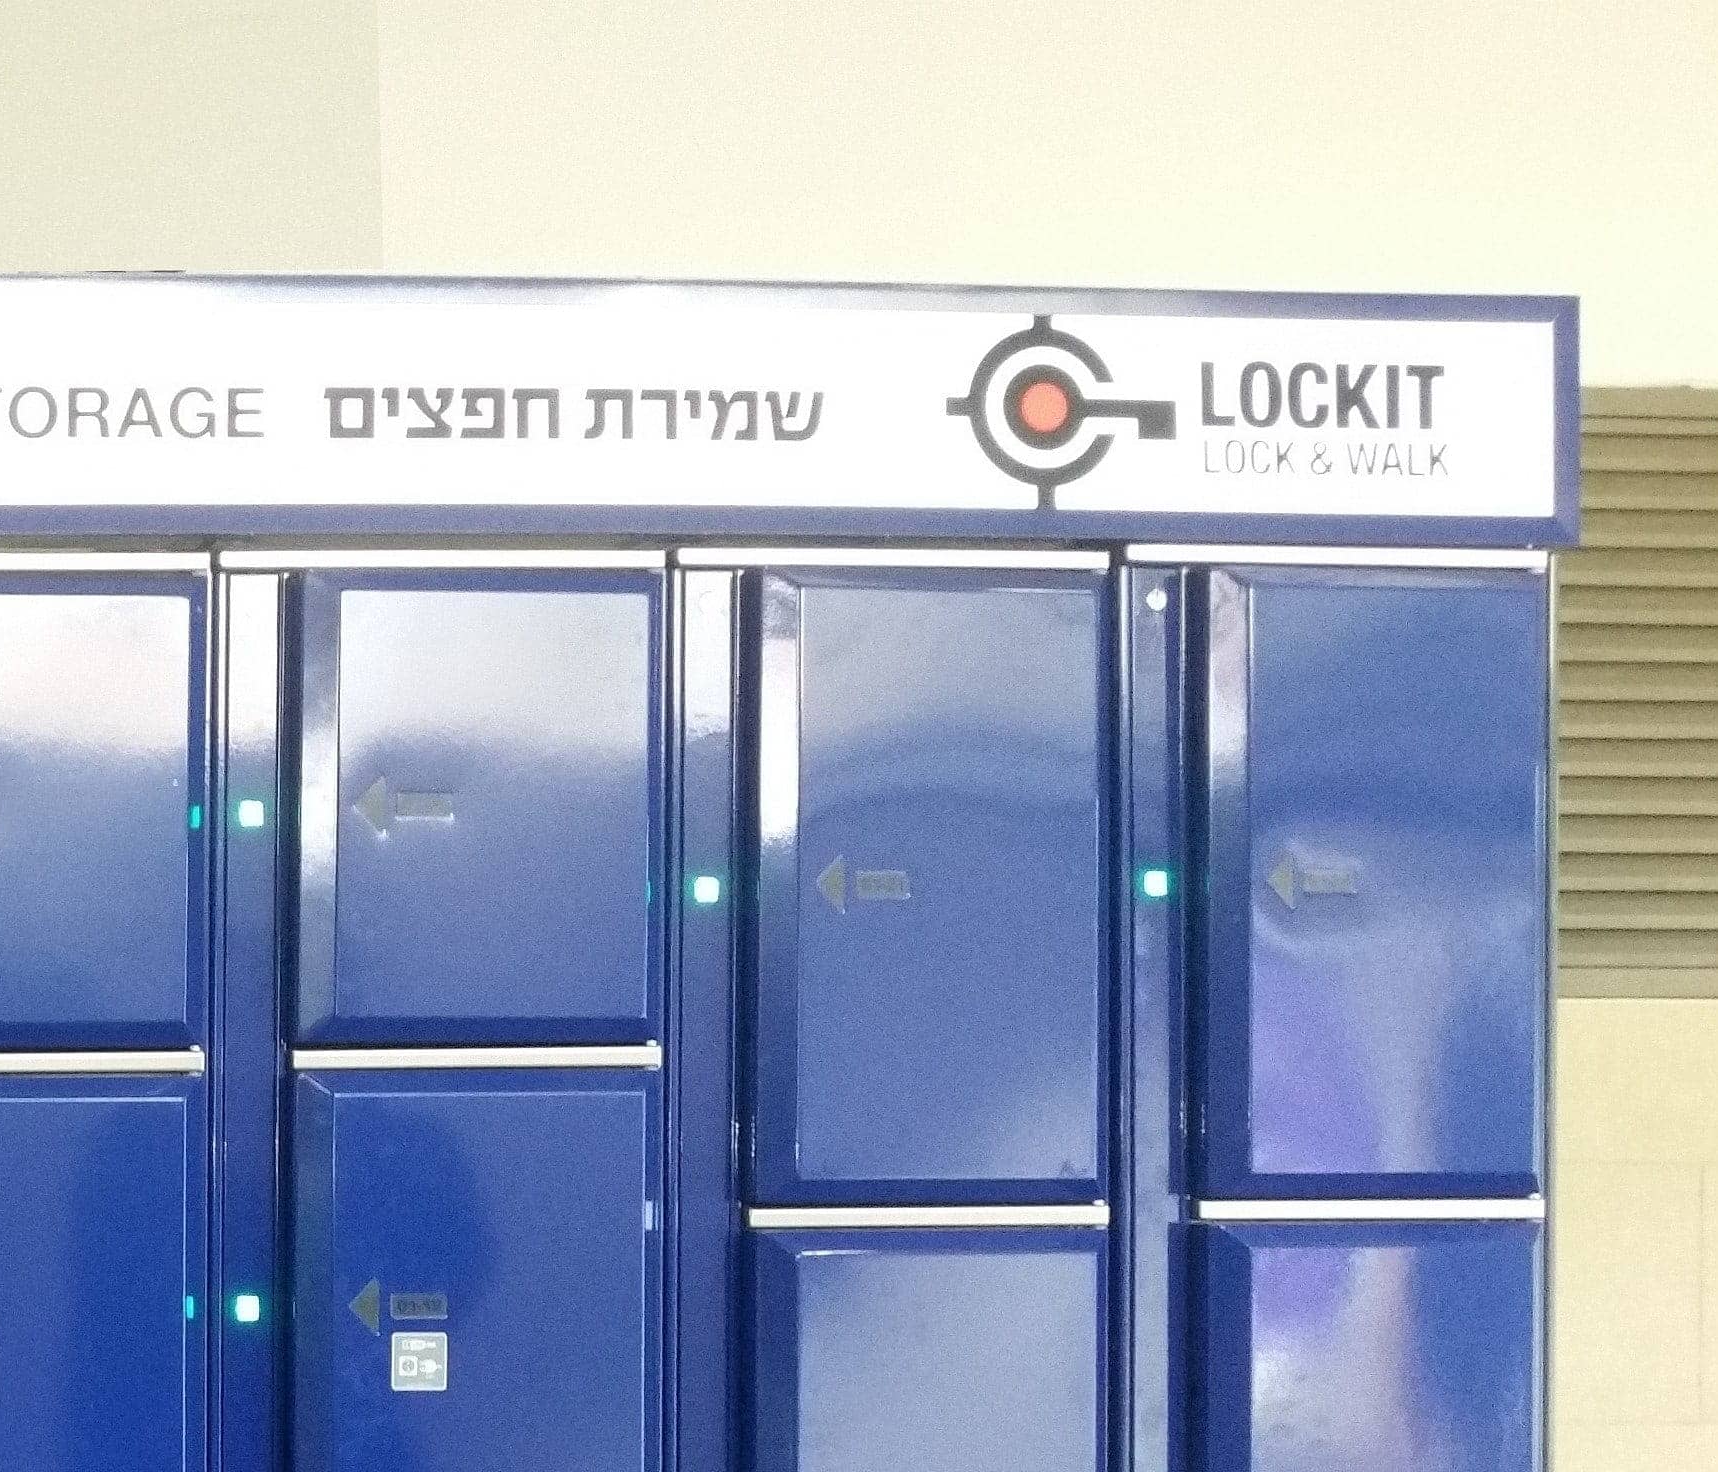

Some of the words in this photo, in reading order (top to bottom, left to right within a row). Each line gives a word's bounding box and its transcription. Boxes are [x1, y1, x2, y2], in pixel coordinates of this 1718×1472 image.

[323, 386, 560, 440] חפצים
[583, 388, 825, 442] שמירת
[1200, 361, 1445, 431] LOCKIT
[1204, 439, 1295, 475] LOCK
[1309, 441, 1333, 476] &
[1346, 442, 1449, 477] WALK
